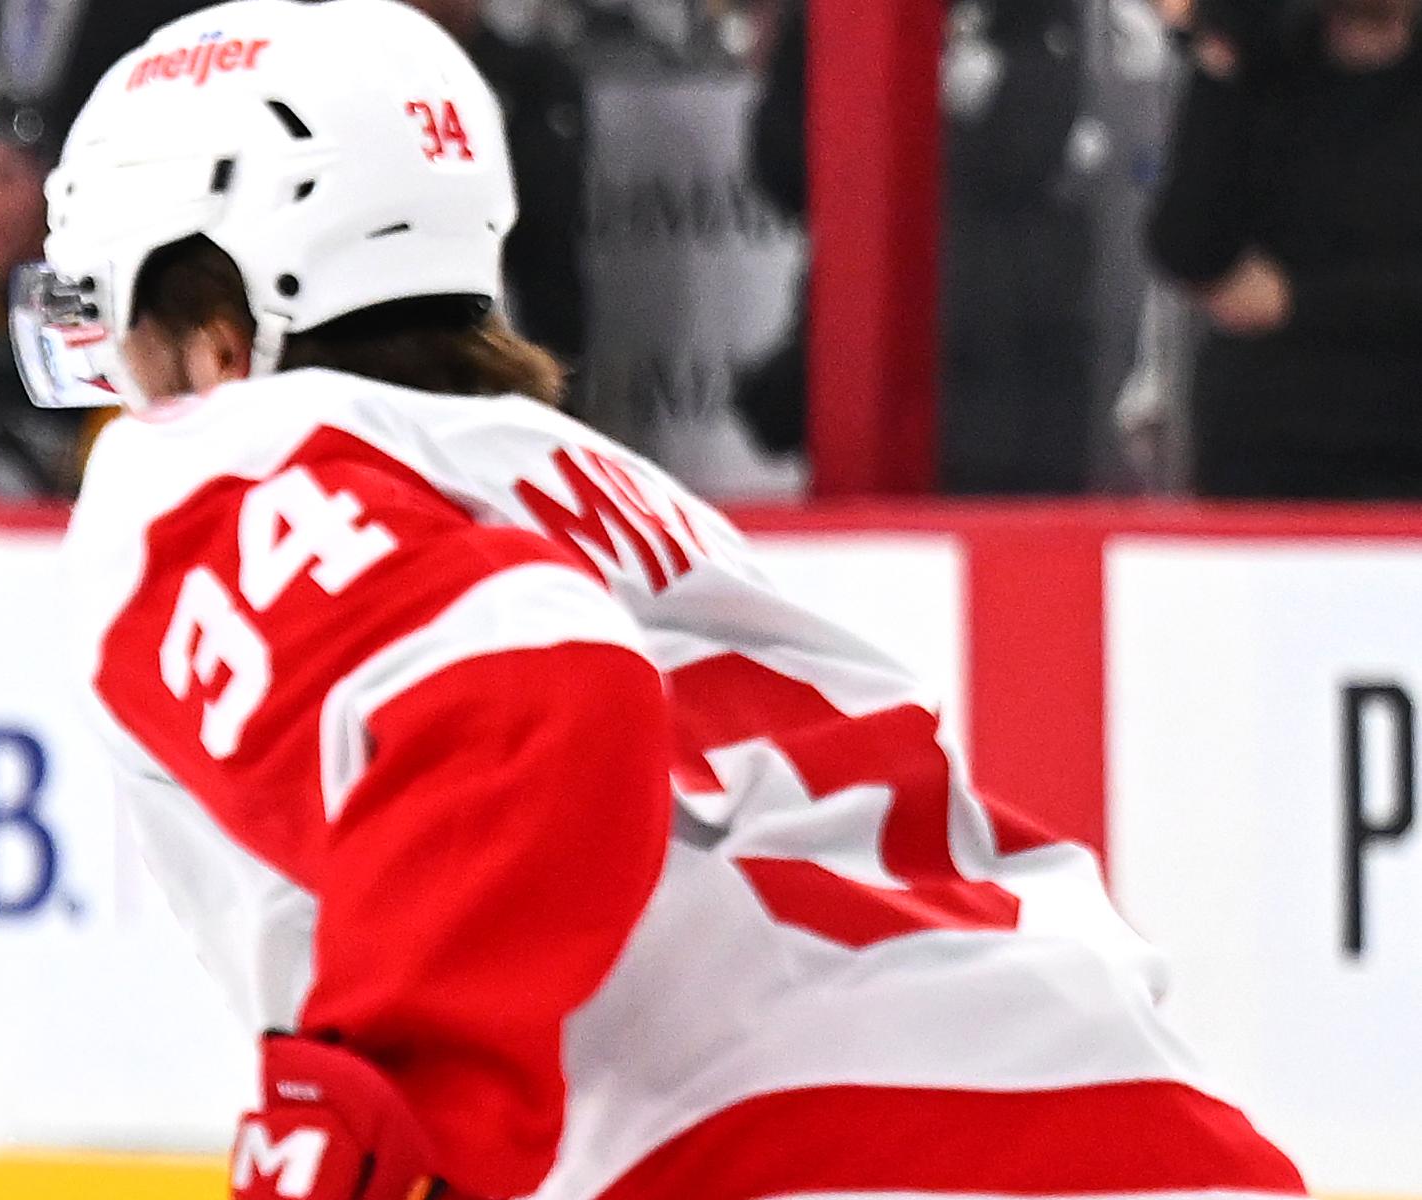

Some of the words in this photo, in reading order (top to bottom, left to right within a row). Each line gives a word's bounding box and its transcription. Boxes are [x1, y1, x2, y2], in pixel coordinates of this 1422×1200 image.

[125, 31, 271, 92] meijer
[405, 99, 475, 163] 34
[157, 462, 401, 760] 34
